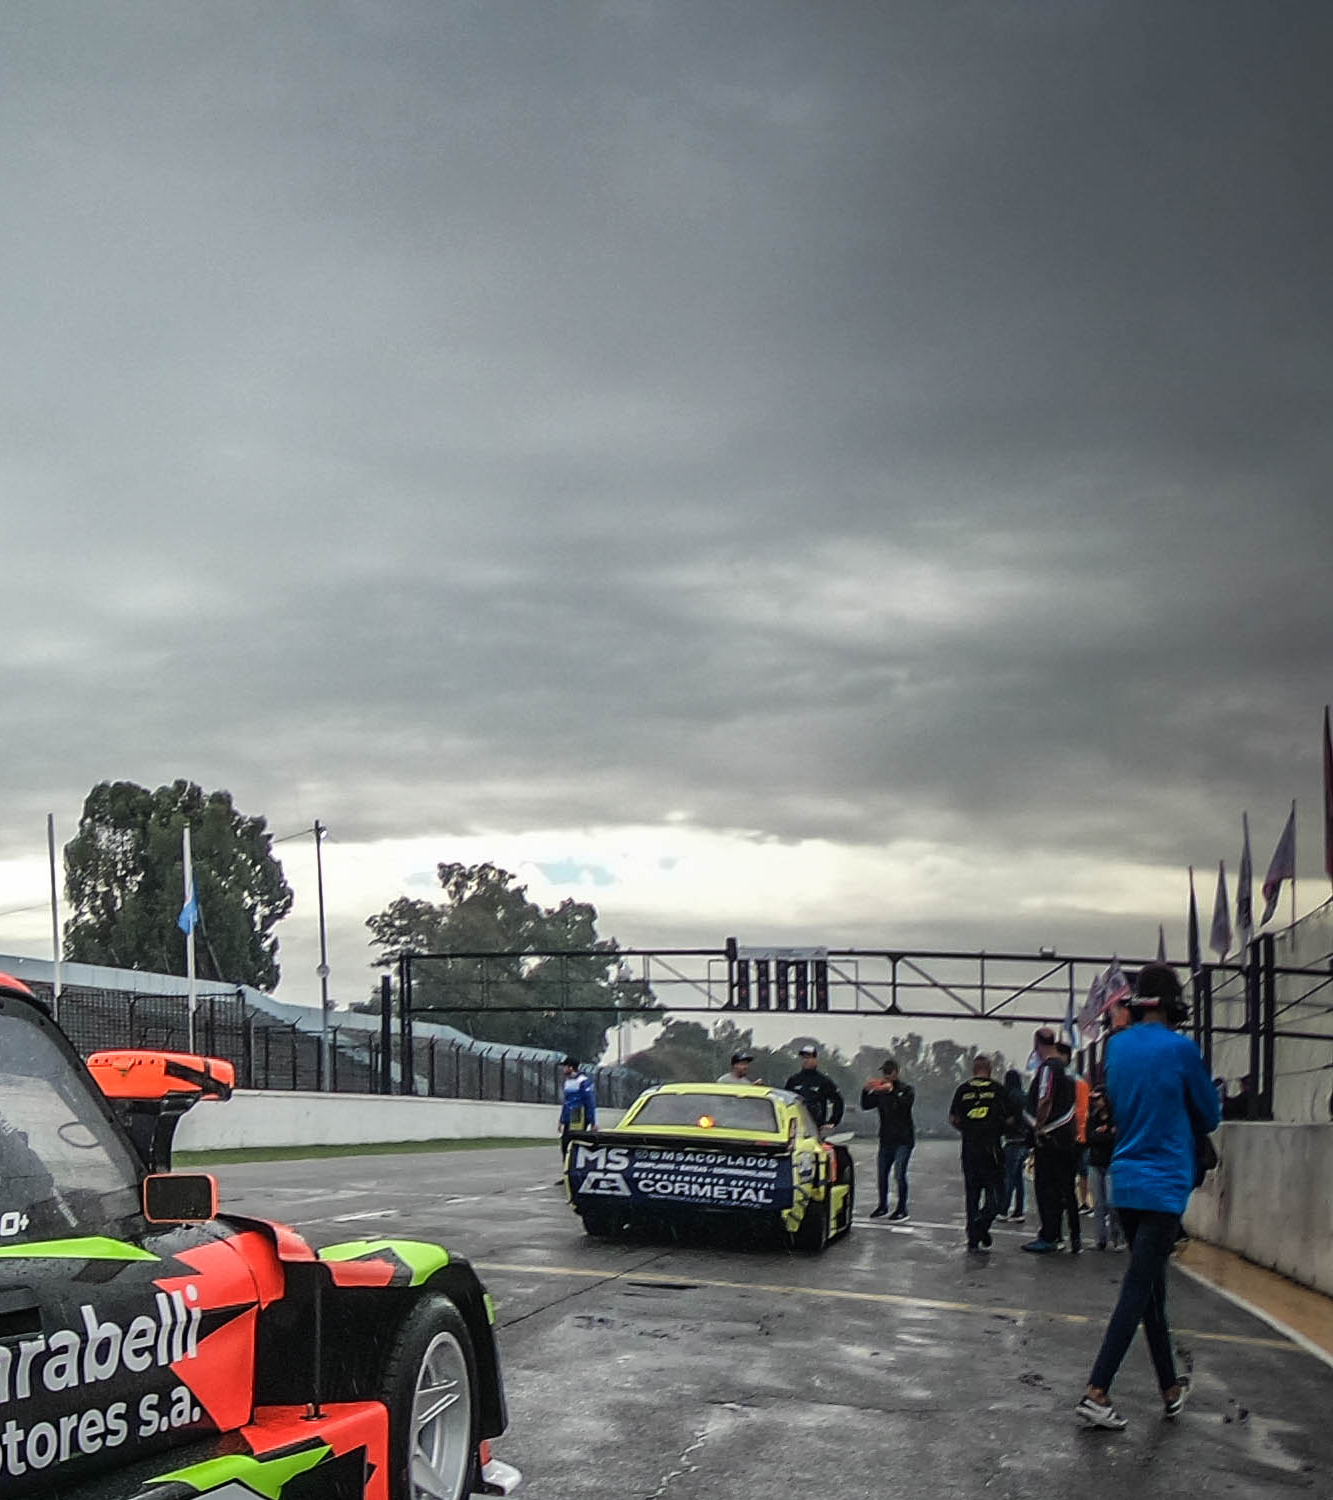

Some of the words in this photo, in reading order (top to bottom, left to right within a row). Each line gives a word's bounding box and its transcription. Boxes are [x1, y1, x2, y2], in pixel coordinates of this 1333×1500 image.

[575, 1147, 630, 1171] MS
[637, 1179, 774, 1203] CORMETAL
[138, 1386, 201, 1438] s.a.
